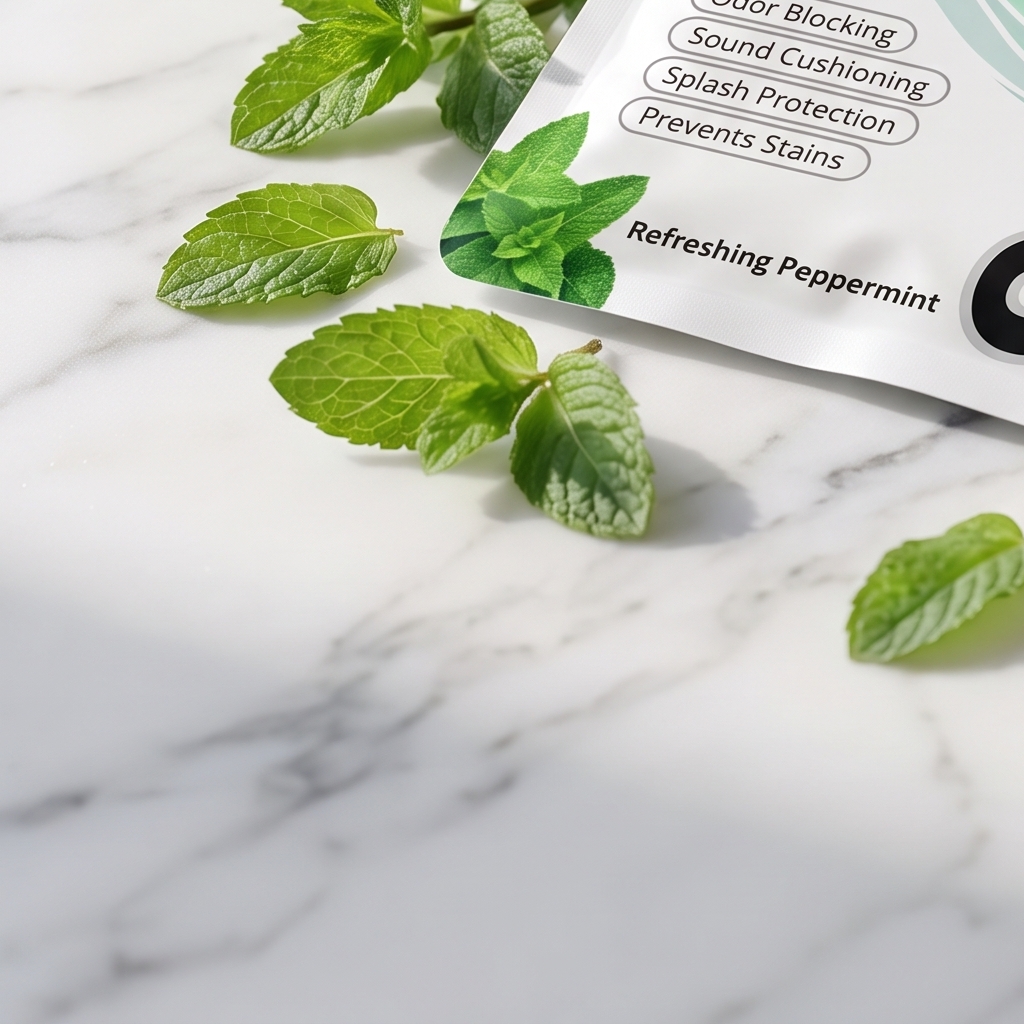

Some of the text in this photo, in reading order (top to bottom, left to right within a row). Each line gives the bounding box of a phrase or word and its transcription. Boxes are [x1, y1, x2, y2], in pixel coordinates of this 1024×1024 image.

[783, 2, 898, 49] Blocking
[687, 26, 930, 102] Sound Cushioning
[661, 65, 896, 135] Splash Protection
[638, 106, 845, 170] Prevents Stains
[626, 220, 941, 313] Refreshing Peppermint
